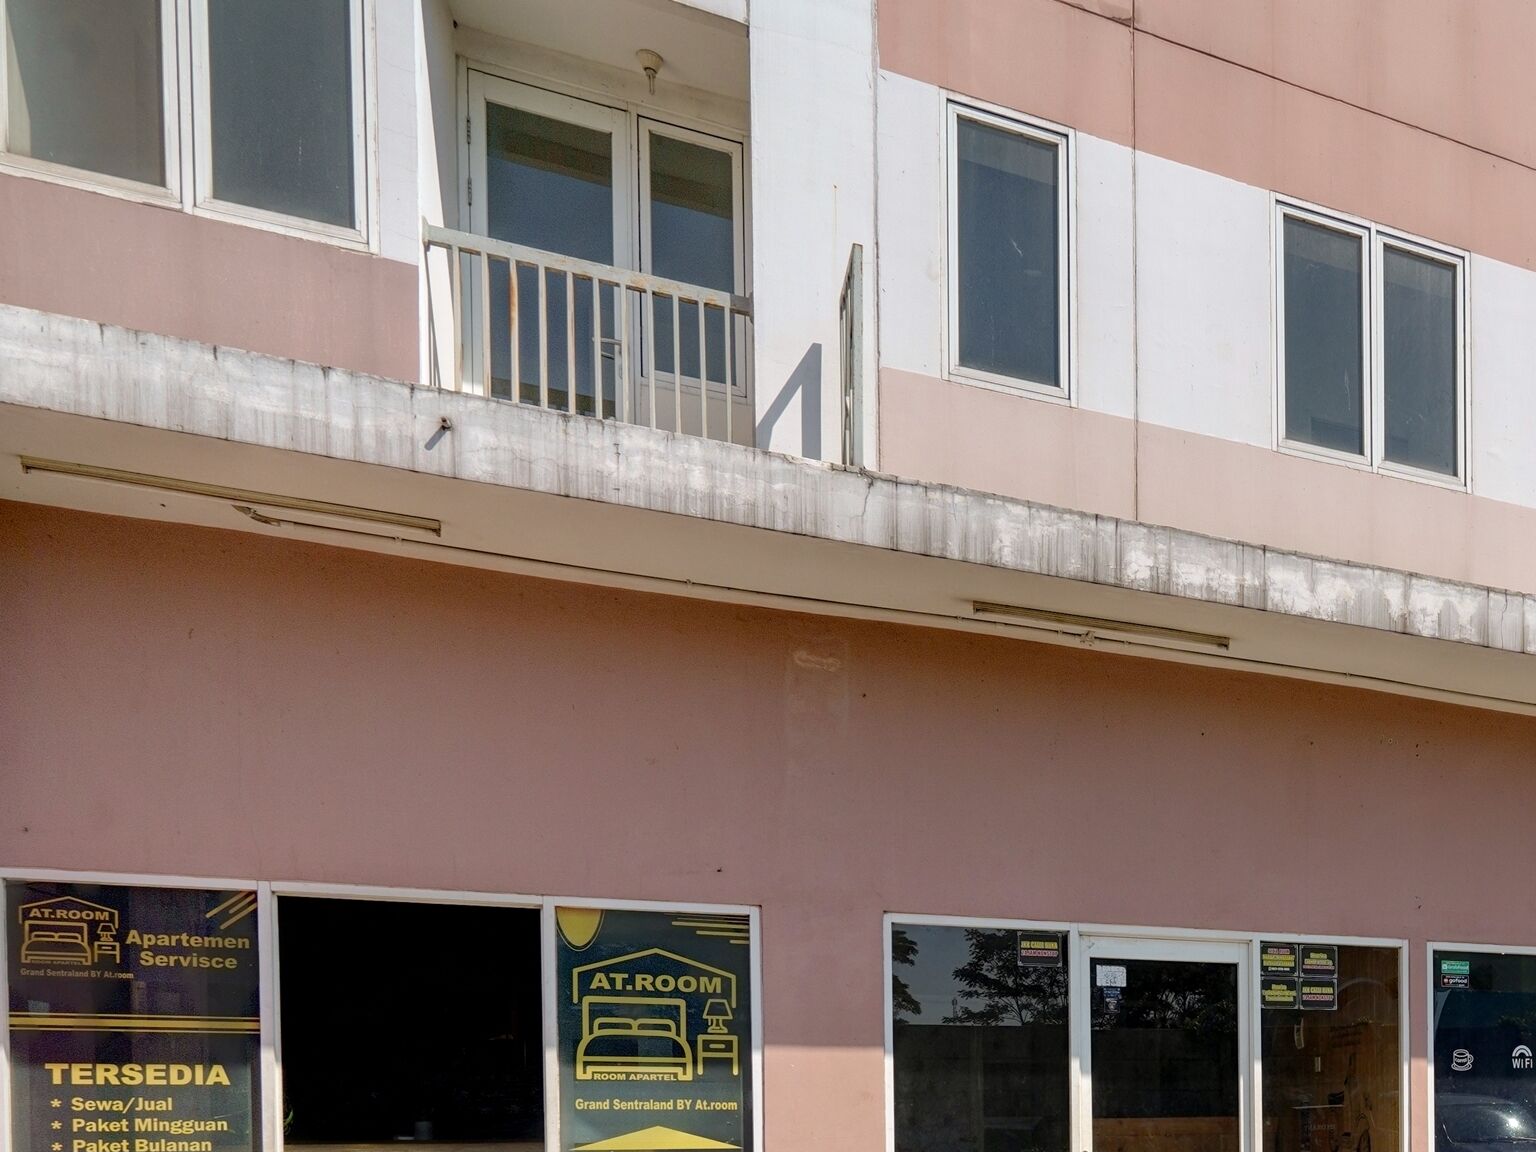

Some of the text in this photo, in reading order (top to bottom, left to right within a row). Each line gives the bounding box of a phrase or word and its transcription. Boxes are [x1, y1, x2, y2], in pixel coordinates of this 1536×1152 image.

[29, 908, 110, 921] AT.ROOM
[126, 930, 250, 949] Apartemen
[140, 951, 238, 969] Servisce
[20, 968, 134, 979] Grand Sentraland BY At.room
[590, 972, 722, 993] AT.ROOM
[45, 1063, 231, 1086] TERSEDIA
[71, 1097, 173, 1114] Sewa/Jual
[575, 1098, 738, 1111] Grand Sentraland BY At.room
[72, 1119, 228, 1135] Paket Mingguan
[72, 1139, 212, 1152] Paket Bulanan
